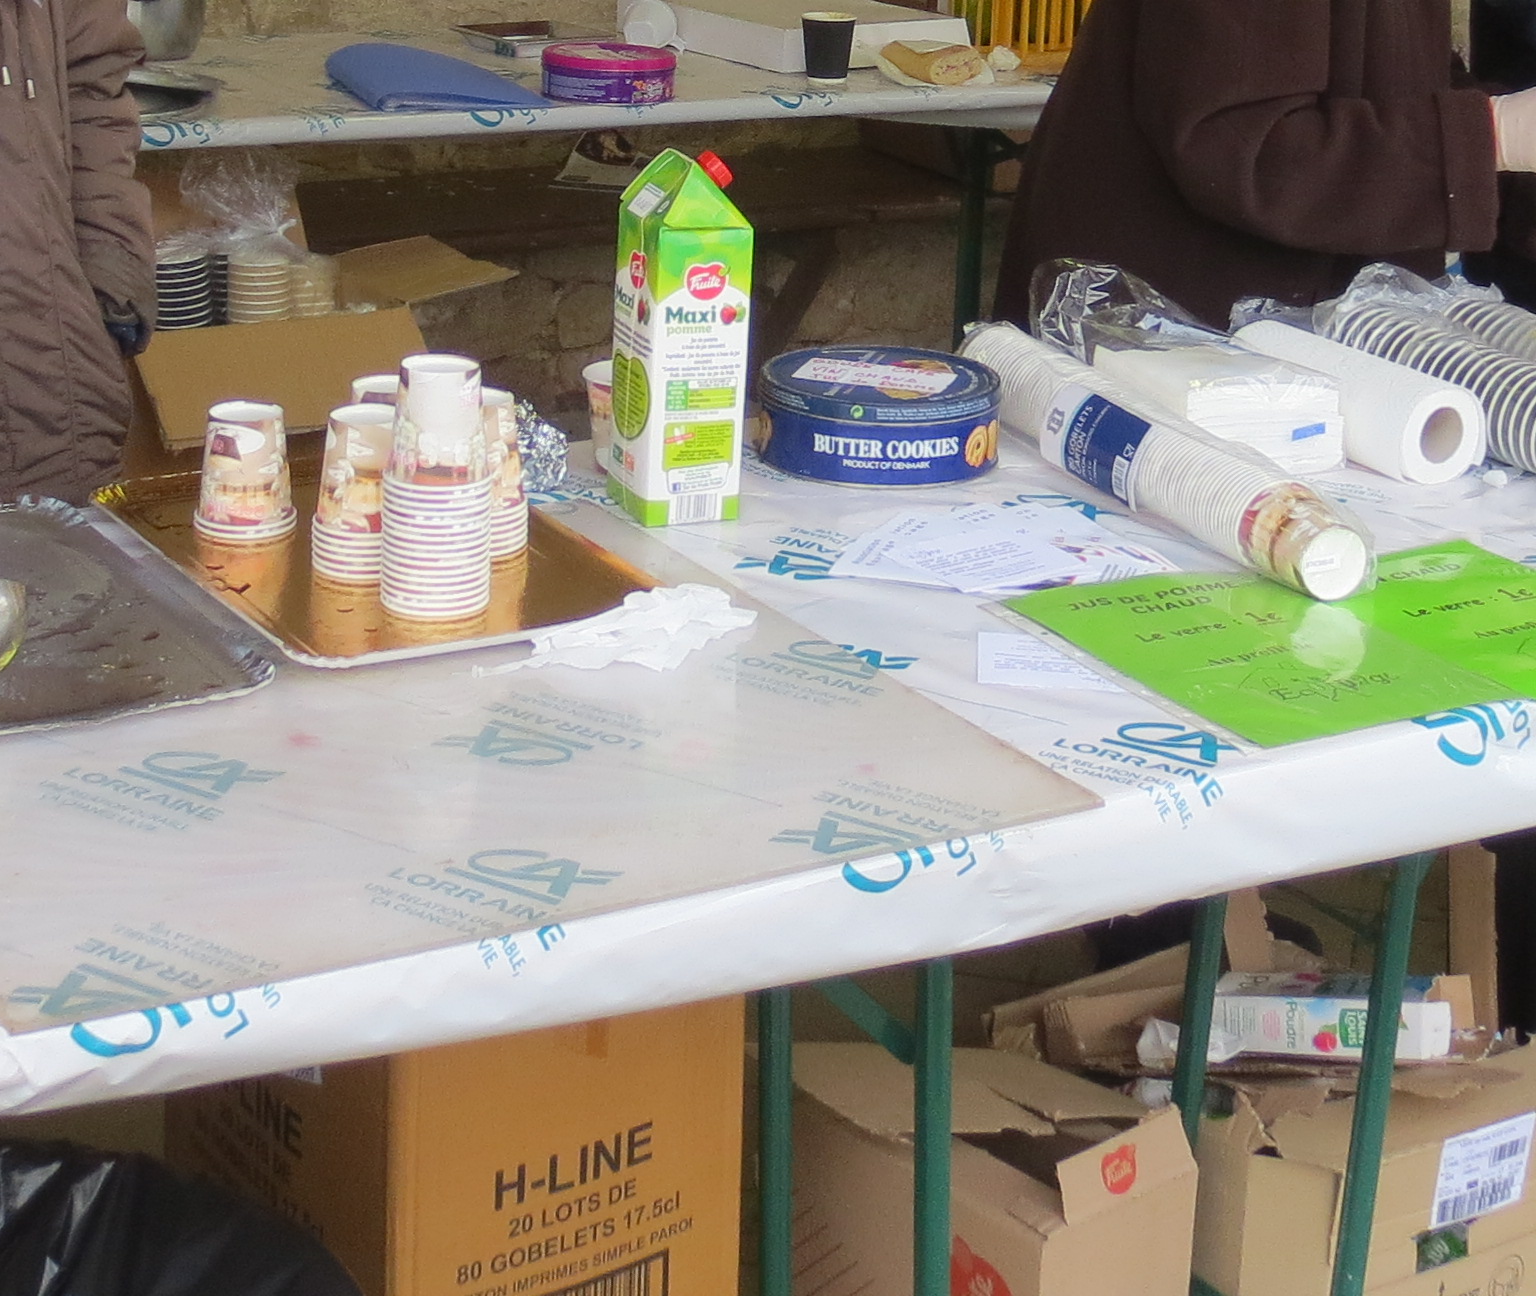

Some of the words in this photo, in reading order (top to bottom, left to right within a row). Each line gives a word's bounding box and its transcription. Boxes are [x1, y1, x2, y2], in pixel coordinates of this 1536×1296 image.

[665, 305, 717, 324] Maxi
[666, 326, 713, 337] pomme
[813, 432, 883, 459] BUTTER
[886, 436, 960, 459] COOKIES
[842, 458, 879, 469] PRODUCT
[880, 460, 891, 470] OF
[892, 460, 930, 470] DENMARK
[1389, 563, 1462, 581] CHAUD
[1069, 596, 1114, 612] JUS
[1117, 592, 1150, 605] DE
[1158, 580, 1240, 600] POMME
[1131, 595, 1213, 615] CHAUD
[1402, 606, 1432, 619] Le
[1433, 597, 1486, 613] verre
[1136, 629, 1166, 644] Le
[1169, 622, 1227, 638] verre
[1052, 737, 1224, 808] LORRAINE
[1072, 766, 1137, 787] CHANGE
[1137, 780, 1154, 798] LA
[1038, 750, 1071, 762] UNE
[1073, 757, 1142, 780] RELATION
[1143, 775, 1194, 830] DURABLE,
[387, 866, 566, 952] LORRAINE
[1286, 1001, 1298, 1049] Poudre
[1344, 1010, 1357, 1047] LOUIS
[492, 1120, 655, 1212] H-LINE
[508, 1217, 534, 1240] 20
[541, 1192, 602, 1229] LOTS
[608, 1178, 637, 1206] DE
[456, 1260, 483, 1286] 80
[490, 1217, 616, 1274] GOBELETS
[622, 1190, 681, 1230] 17.5cl
[513, 1257, 589, 1294] IMPRIMES
[592, 1237, 645, 1268] SIMPLE
[649, 1216, 694, 1246] PAROI
